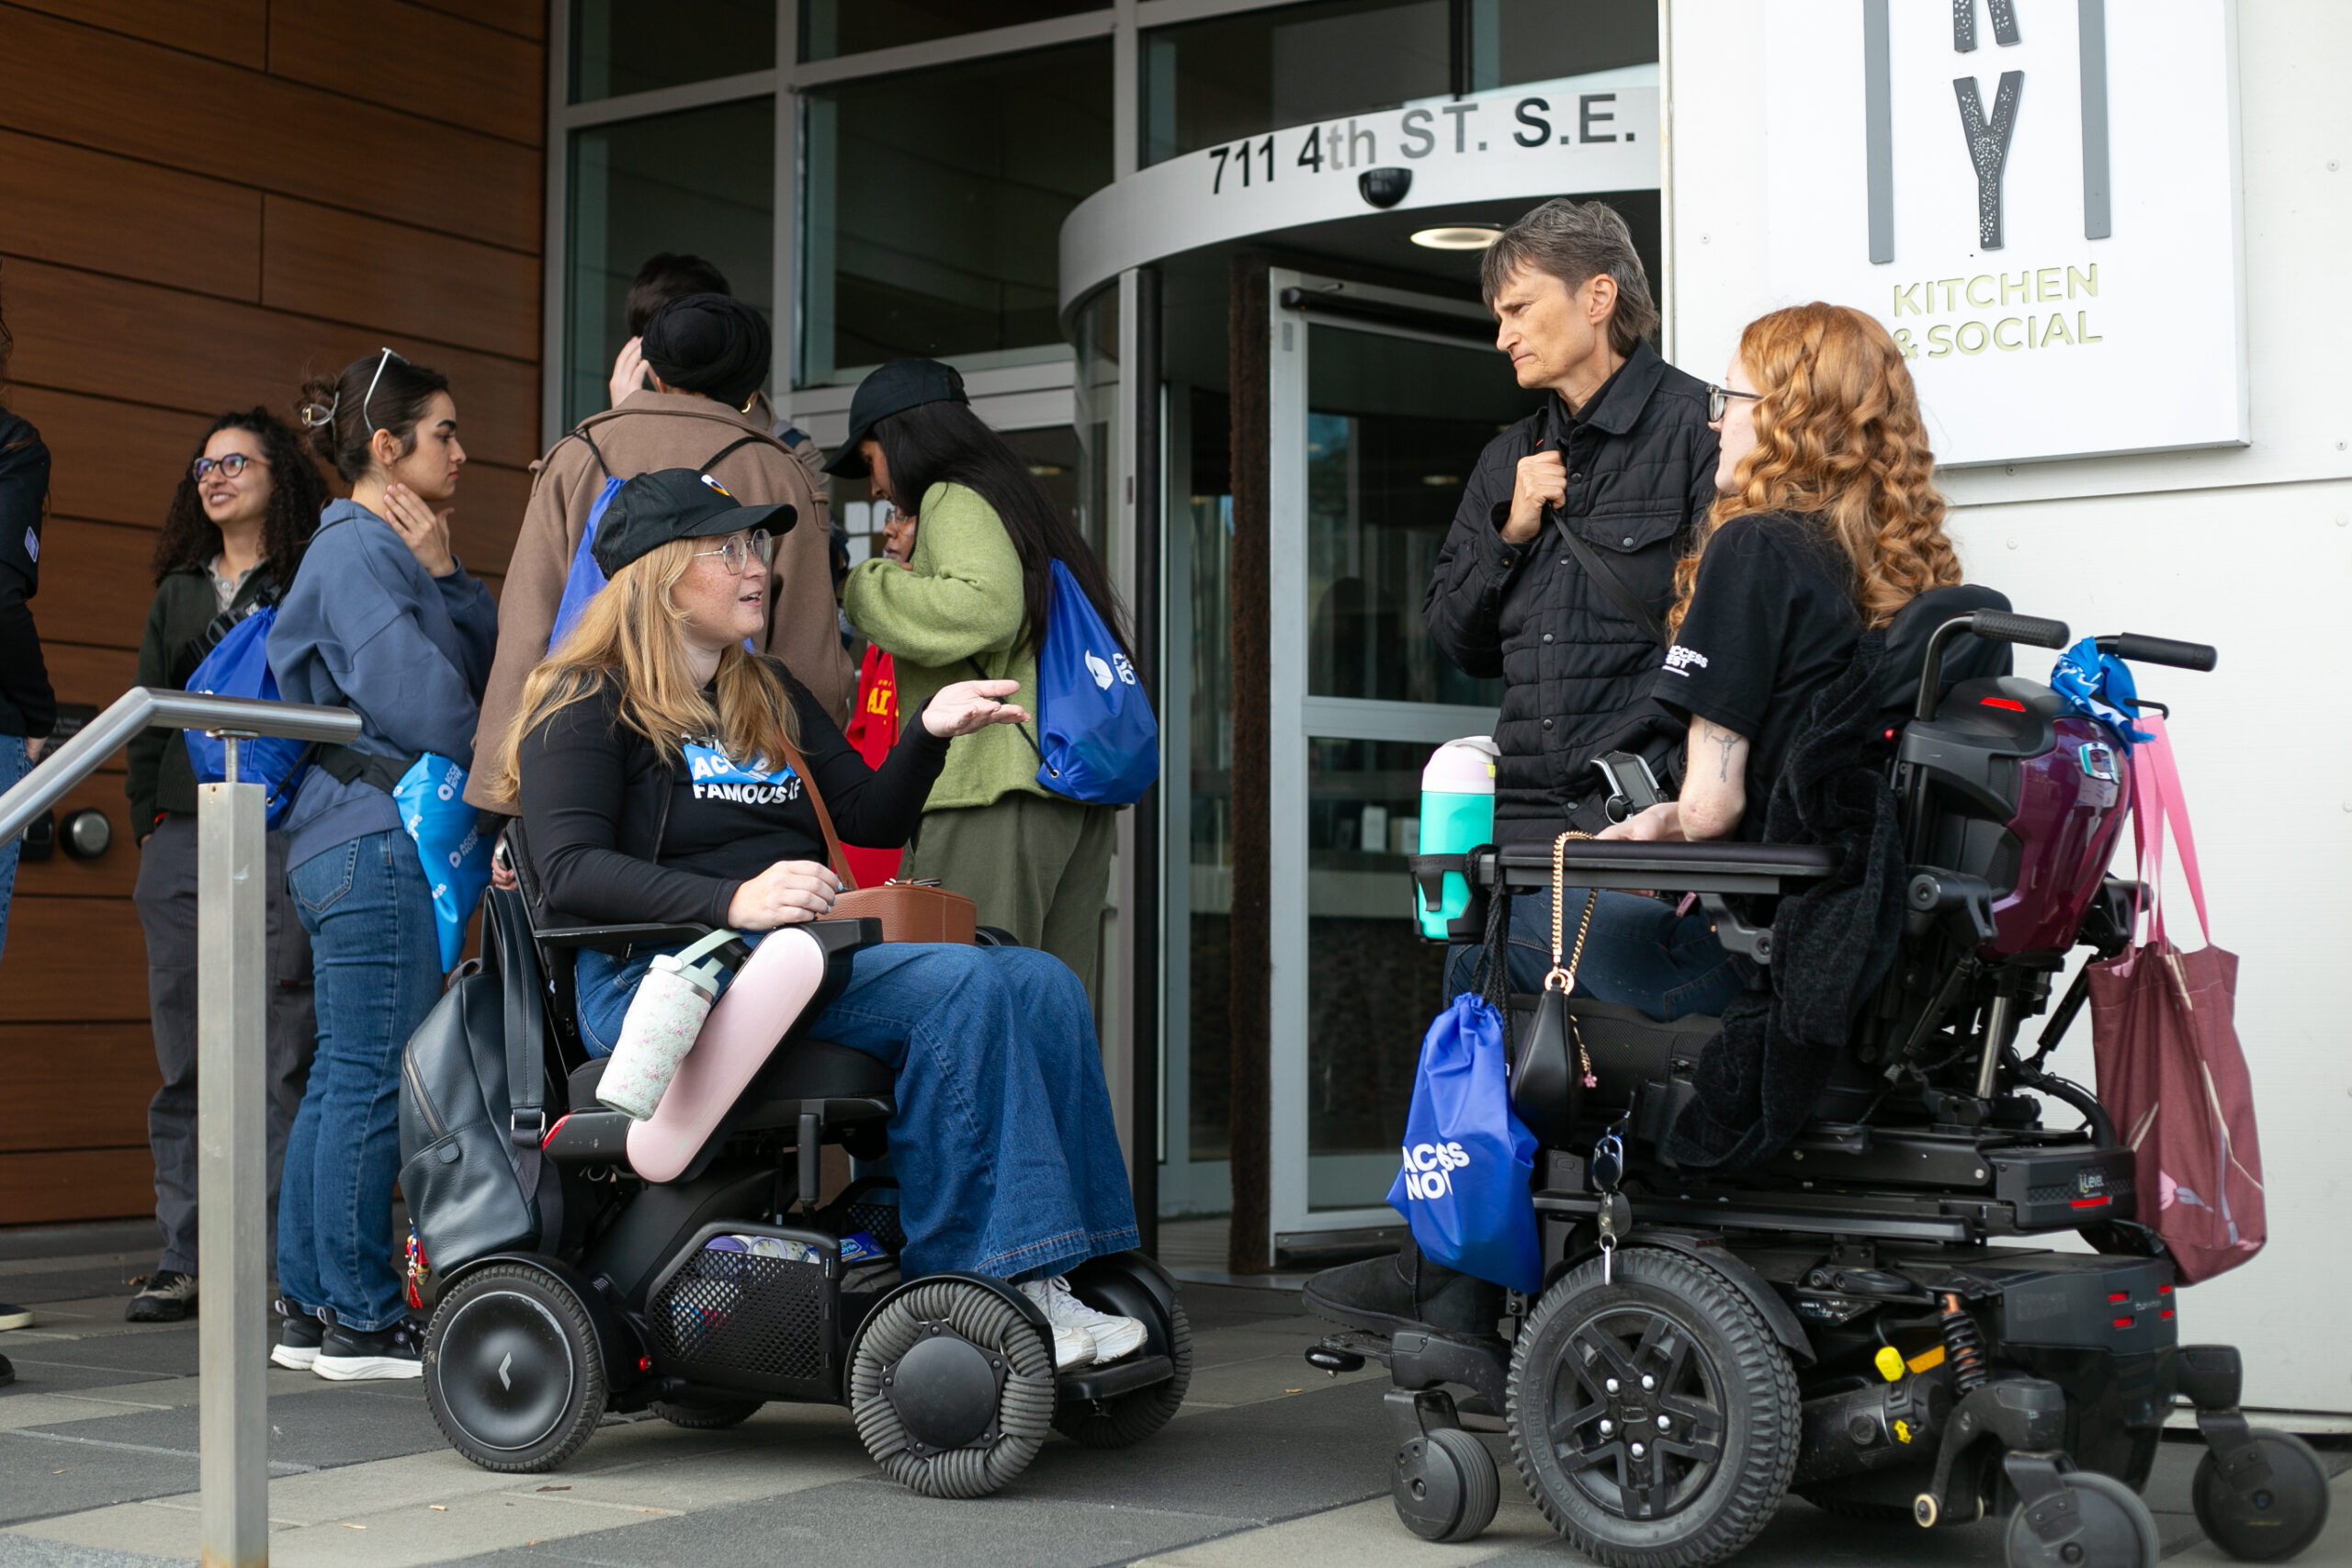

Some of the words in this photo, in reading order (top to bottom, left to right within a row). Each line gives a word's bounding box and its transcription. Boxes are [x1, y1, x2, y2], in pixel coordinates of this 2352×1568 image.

[1209, 134, 1274, 195] 711
[1297, 119, 1376, 173] 4th
[1399, 102, 1487, 159] ST.
[1512, 93, 1635, 148] S.E.
[1894, 263, 2098, 318] KITCHEN
[1927, 310, 2103, 359] SOCIAL
[692, 783, 787, 805] FAMOUS
